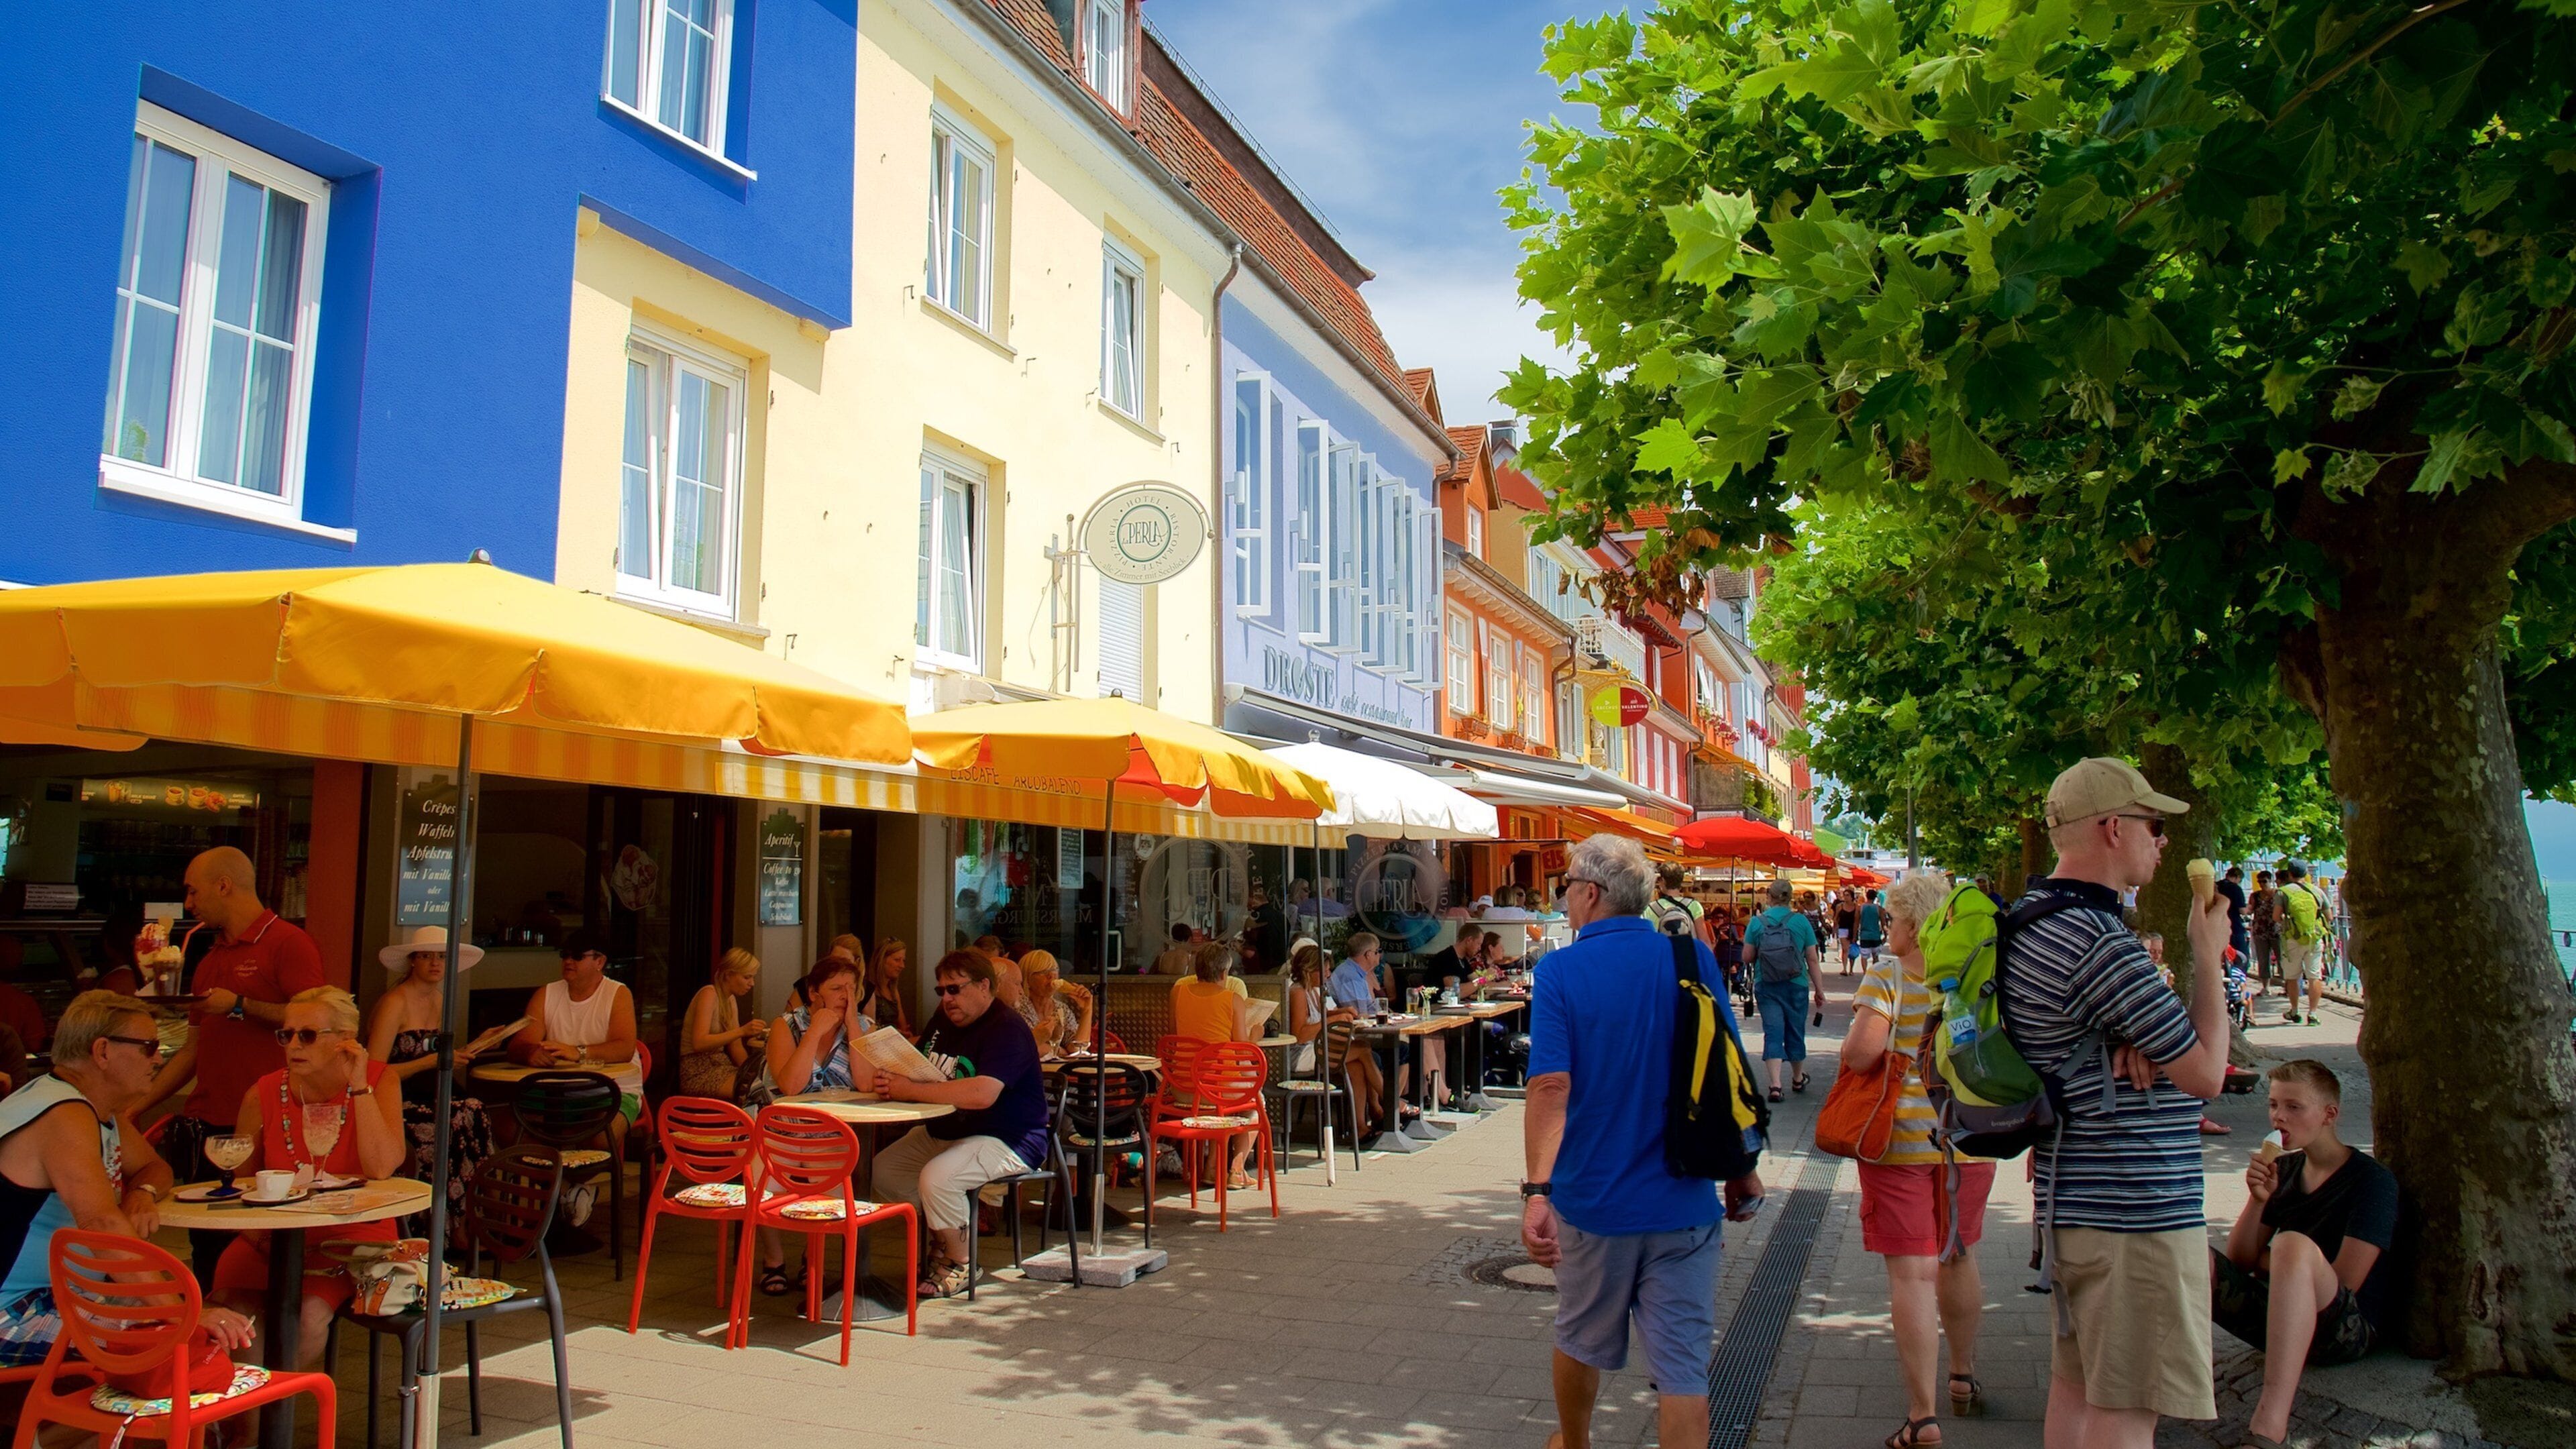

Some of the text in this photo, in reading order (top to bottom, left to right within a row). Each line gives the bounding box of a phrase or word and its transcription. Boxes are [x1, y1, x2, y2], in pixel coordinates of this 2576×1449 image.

[1126, 495, 1161, 508] HOTEL
[1109, 517, 1128, 567] PIZZERIA
[1122, 521, 1168, 547] PERLA
[1142, 513, 1181, 571] RISTORANTE
[1263, 643, 1336, 710] DROSTE
[423, 799, 456, 816] Crêpes
[764, 833, 795, 848] Aperitif
[1542, 849, 1565, 869] EIS
[403, 869, 419, 881] mit
[763, 862, 784, 877] Coffee
[786, 865, 792, 874] to
[427, 885, 442, 895] oder
[1366, 878, 1430, 918] PERLA
[404, 902, 420, 912] mit
